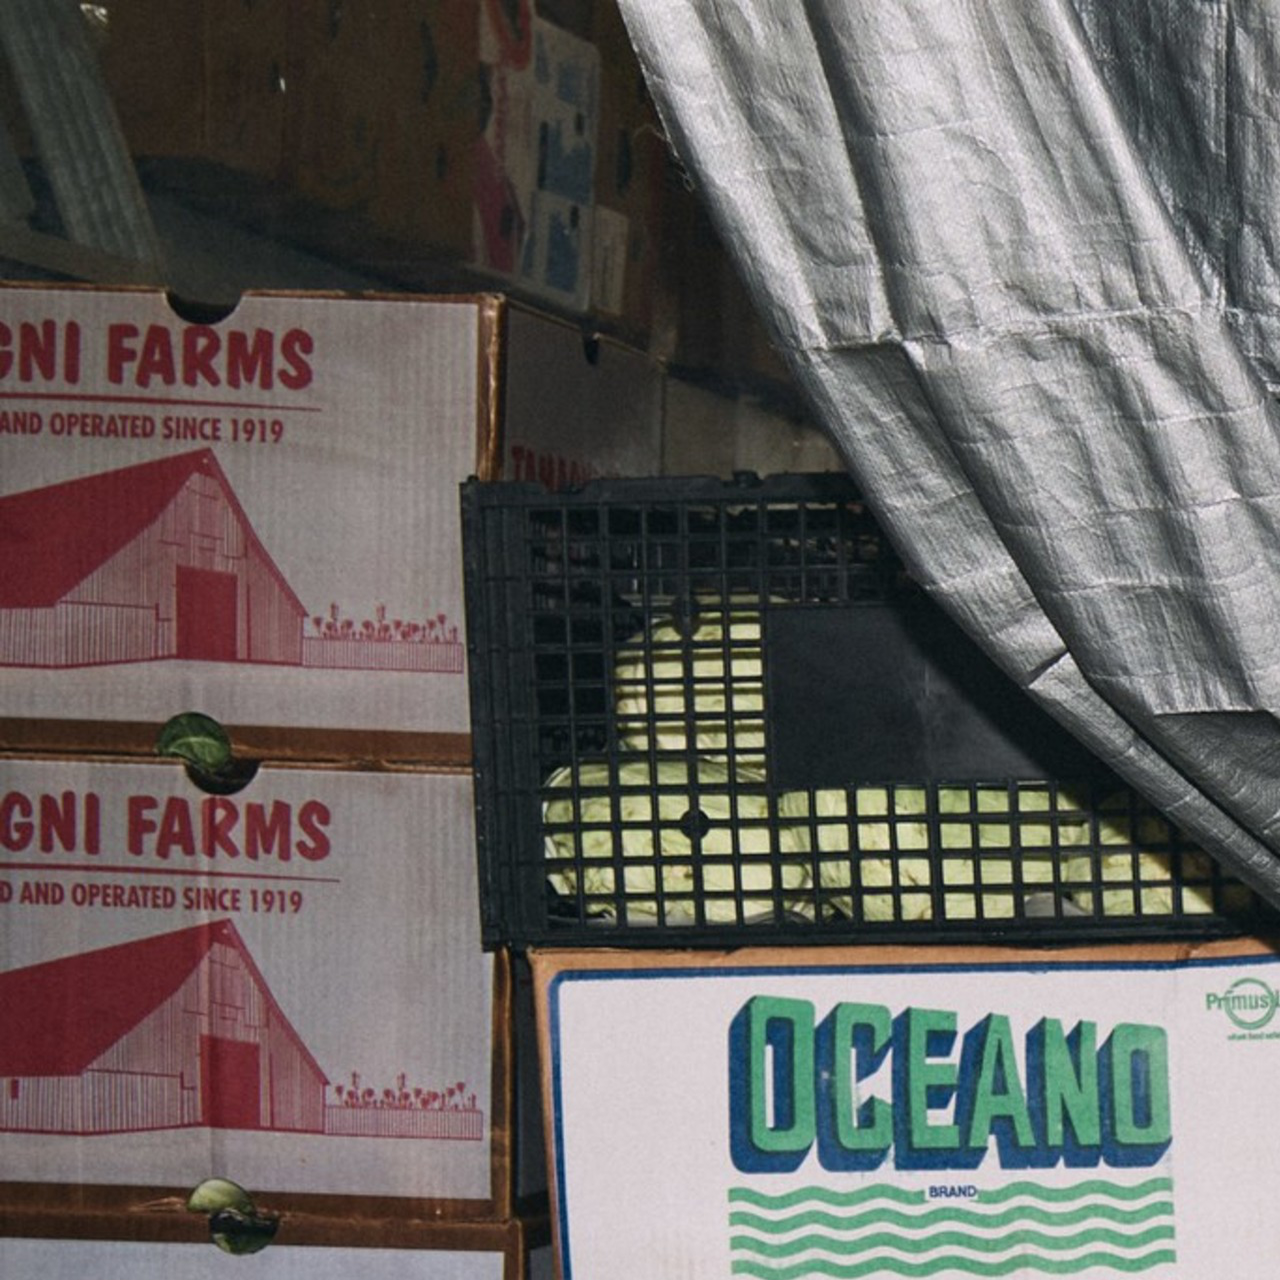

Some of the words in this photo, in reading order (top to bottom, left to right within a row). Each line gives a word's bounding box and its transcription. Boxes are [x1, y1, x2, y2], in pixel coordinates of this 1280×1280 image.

[107, 323, 314, 391] FARMS
[0, 411, 43, 436] AND
[50, 412, 155, 440] OPERATED
[162, 417, 221, 442] SINCE
[230, 419, 284, 444] 1919
[0, 790, 101, 856] GNI
[127, 794, 332, 862] FARMS
[20, 881, 65, 905] AND
[71, 883, 177, 910] OPERATED
[183, 887, 241, 912] SINCE
[250, 889, 304, 915] 1919
[729, 994, 1173, 1174] OCEANO
[929, 1186, 977, 1200] BRAND
